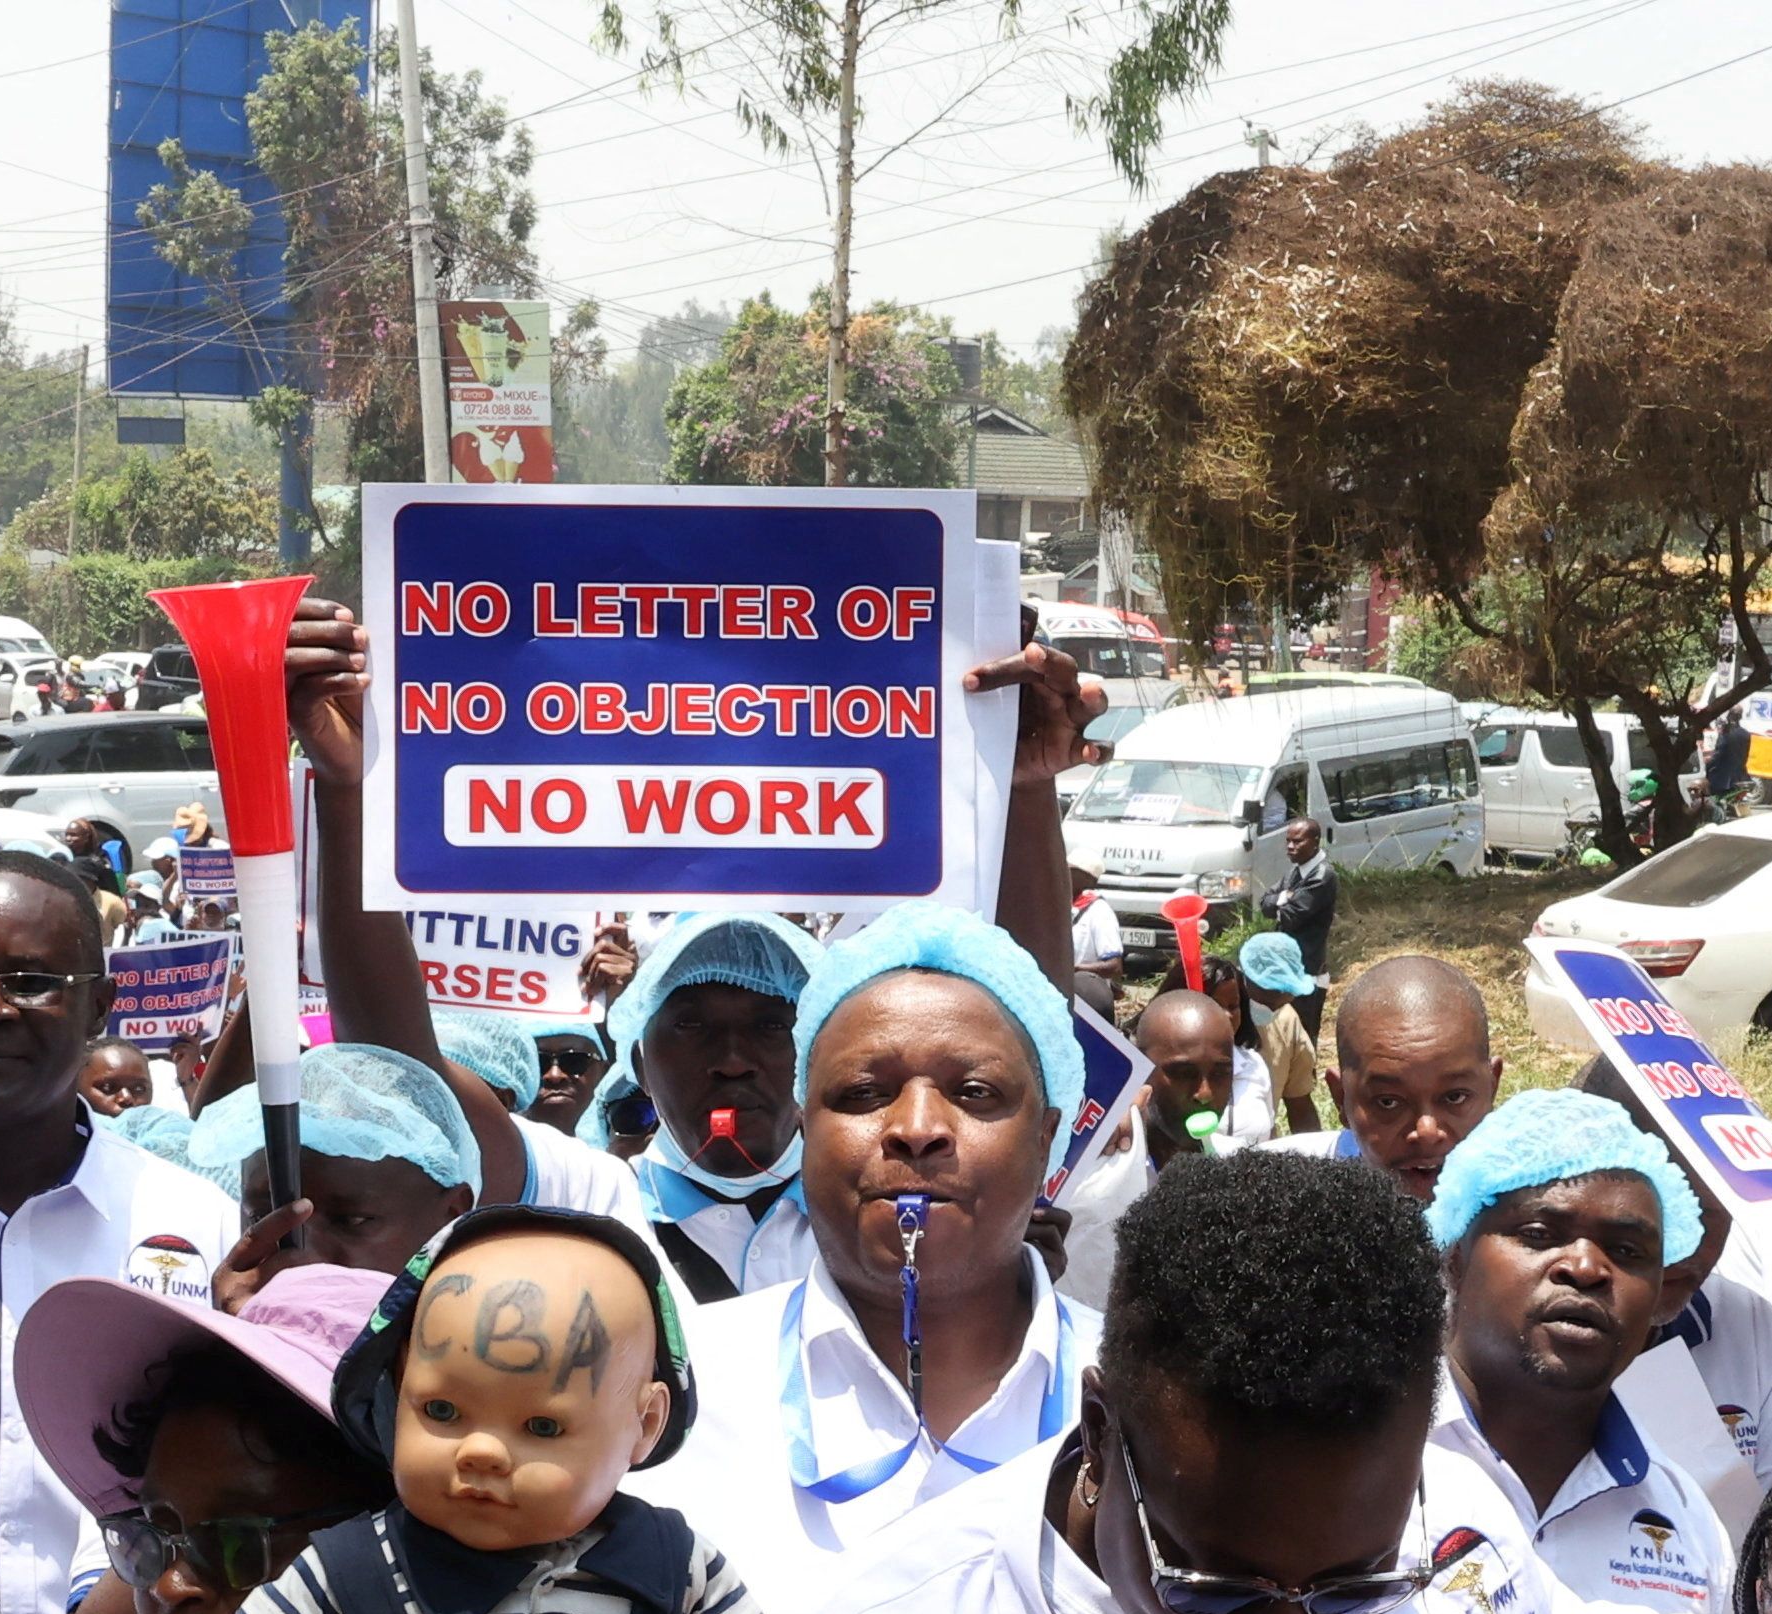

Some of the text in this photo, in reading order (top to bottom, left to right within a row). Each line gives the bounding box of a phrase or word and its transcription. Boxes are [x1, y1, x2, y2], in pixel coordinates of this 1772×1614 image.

[503, 390, 538, 401] MIXUE
[464, 403, 489, 415] 0724
[402, 581, 935, 641] NO LETTER OF
[402, 682, 935, 738] NO OBJECTION
[467, 777, 875, 836] NO WORK
[1102, 846, 1165, 862] PRIVATE
[188, 880, 236, 889] NO WORK
[112, 971, 140, 988] NO
[144, 962, 210, 986] LETTER
[111, 986, 223, 1012] NO OBJECTION
[126, 1021, 158, 1036] NO
[1588, 996, 1655, 1036] NO
[1638, 1060, 1702, 1100] NO
